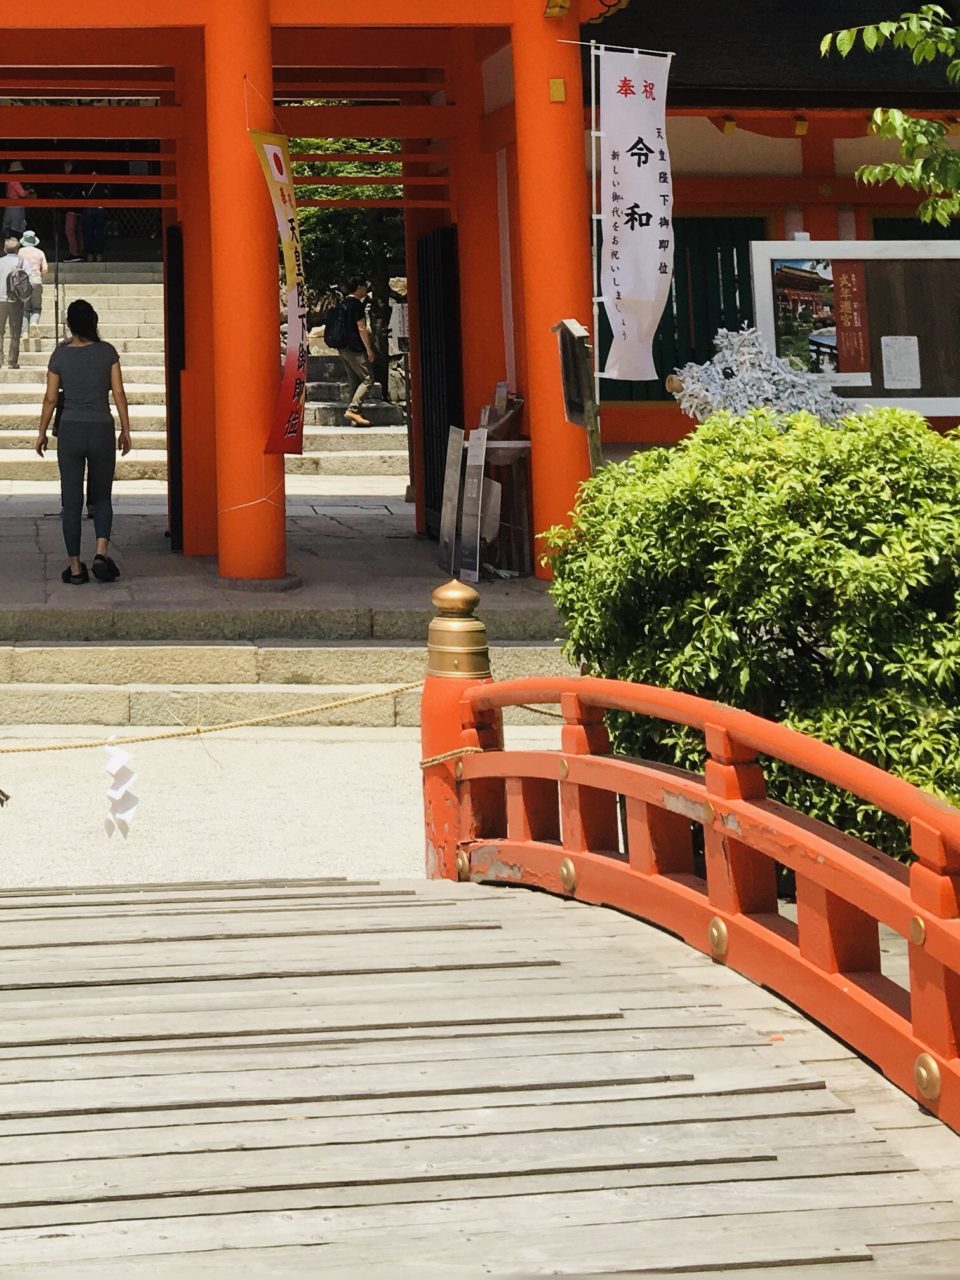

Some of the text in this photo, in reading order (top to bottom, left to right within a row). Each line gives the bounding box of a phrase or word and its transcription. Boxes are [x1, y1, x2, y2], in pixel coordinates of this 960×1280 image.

[616, 76, 656, 101] 奉祝
[624, 136, 655, 231] 令和
[655, 127, 670, 275] 天皇陛下御即位
